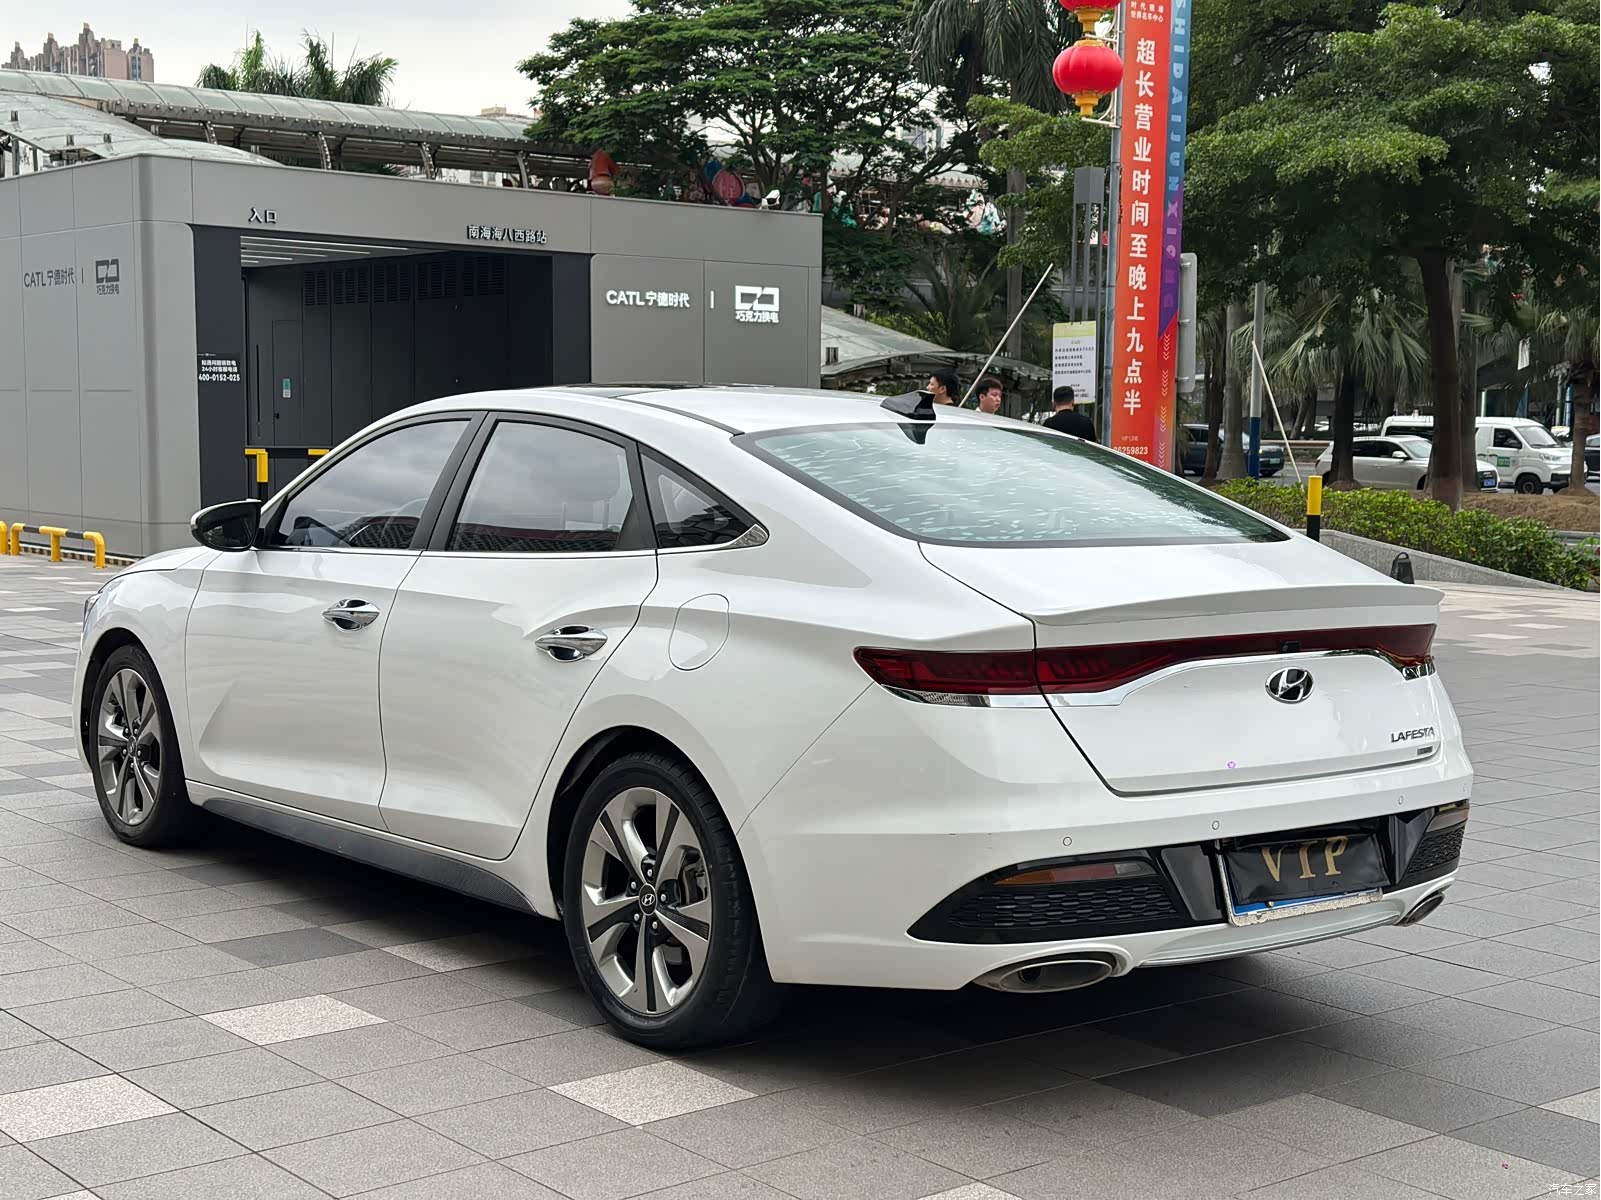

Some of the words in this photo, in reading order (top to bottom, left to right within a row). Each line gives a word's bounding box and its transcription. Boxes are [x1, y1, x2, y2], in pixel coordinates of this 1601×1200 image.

[249, 208, 277, 223] 入口
[467, 225, 547, 244] 南海海八西路站
[1123, 37, 1156, 416] 超长营业时间至晚上九点半
[735, 311, 779, 323] 巧克力换电
[198, 373, 240, 382] 400-0152-025
[1391, 726, 1435, 743] LAFESTA
[1261, 835, 1349, 882] VIP
